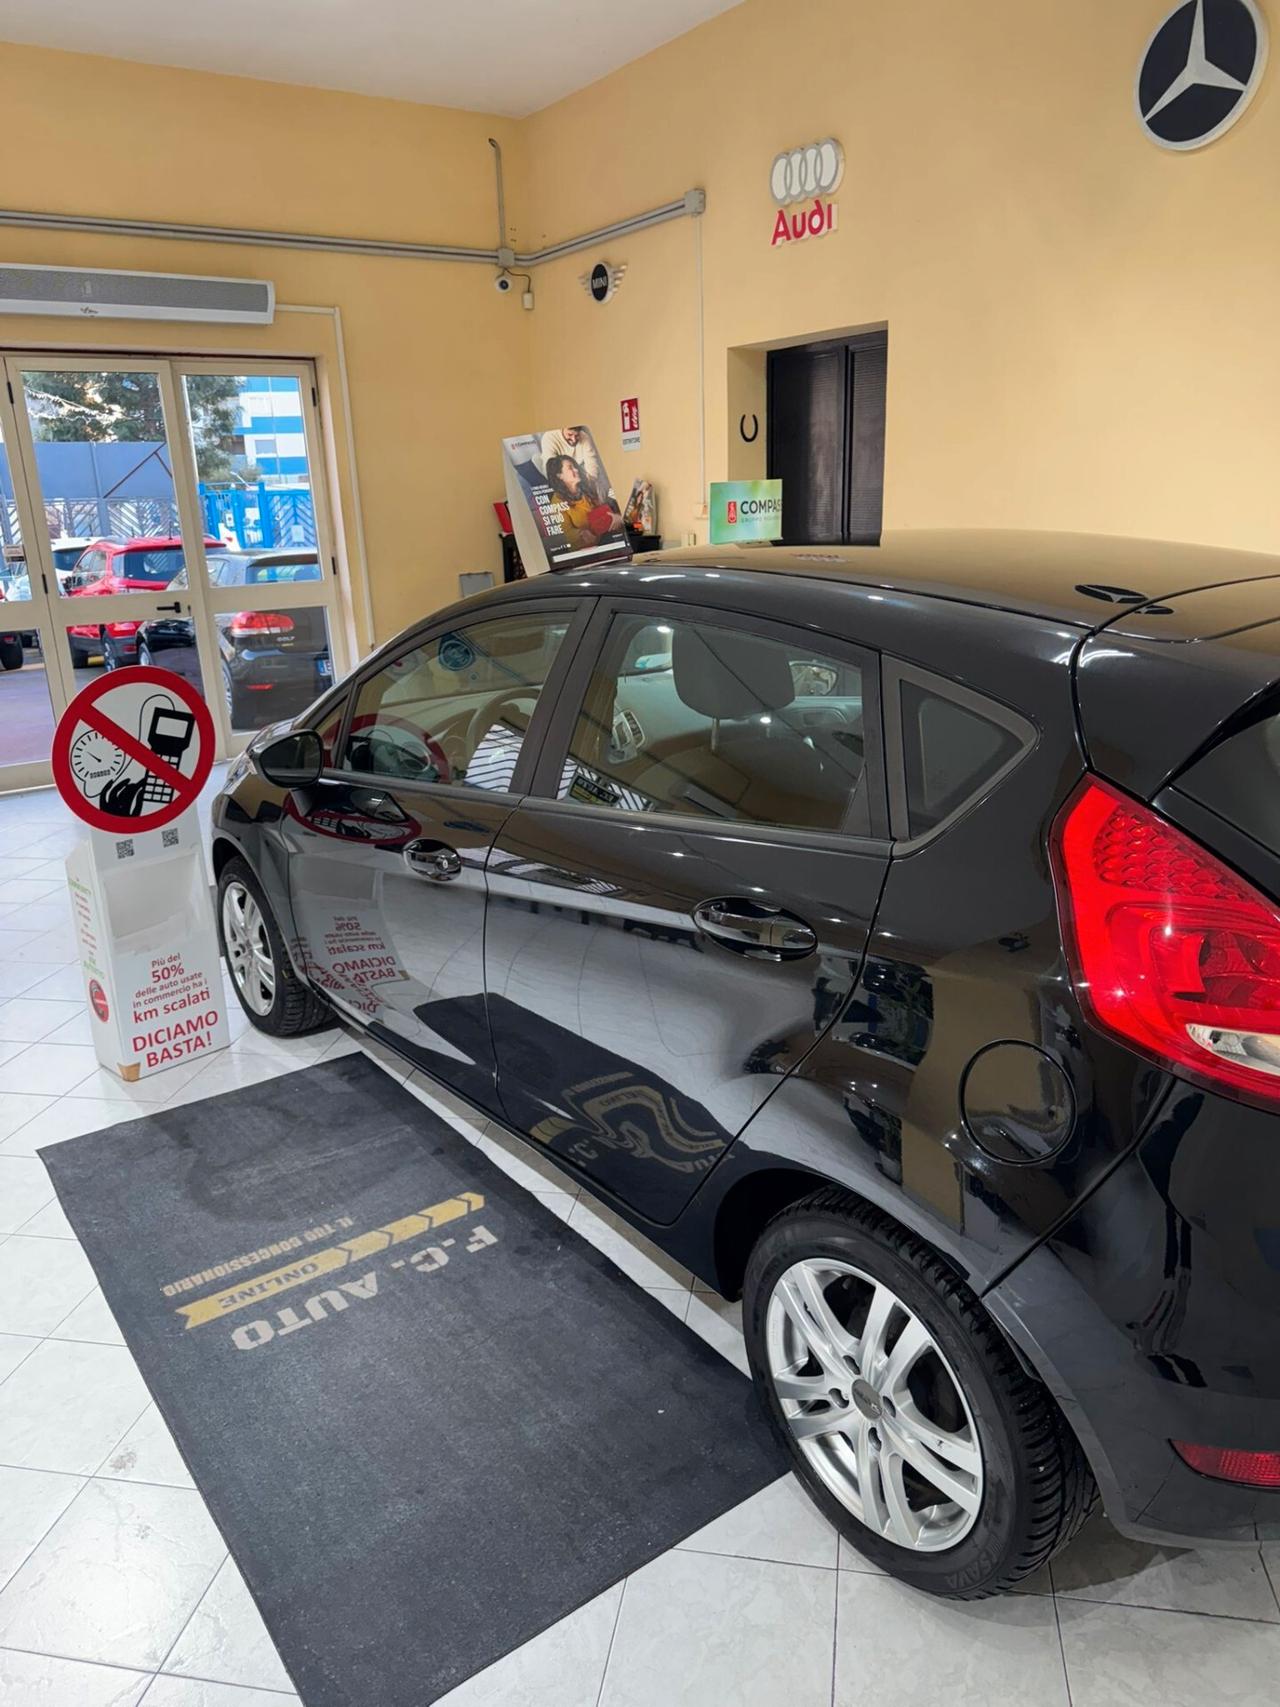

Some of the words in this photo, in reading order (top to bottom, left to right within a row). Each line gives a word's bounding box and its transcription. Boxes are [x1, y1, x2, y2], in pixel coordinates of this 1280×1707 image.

[771, 199, 832, 246] Audi
[535, 494, 551, 506] CON
[539, 501, 570, 516] COMPASS
[546, 525, 564, 536] FARE
[151, 958, 166, 968] Più
[167, 952, 181, 963] del
[152, 962, 184, 984] 50%
[132, 998, 142, 1008] in
[143, 985, 191, 1005] commercio
[192, 979, 203, 988] ha
[135, 986, 157, 998] delle
[159, 980, 179, 991] auto
[181, 971, 203, 984] usate
[133, 1007, 159, 1024] km
[163, 987, 210, 1014] scalati
[132, 1010, 219, 1052] DICIAMO
[146, 1031, 212, 1068] BASTA!
[306, 1223, 337, 1242] TUO
[336, 1216, 354, 1230] IL
[390, 1225, 498, 1273] F.C.
[161, 1235, 303, 1297] CONCESSIONARIO
[218, 1261, 320, 1309] ONLINE
[231, 1270, 378, 1350] AUTO
